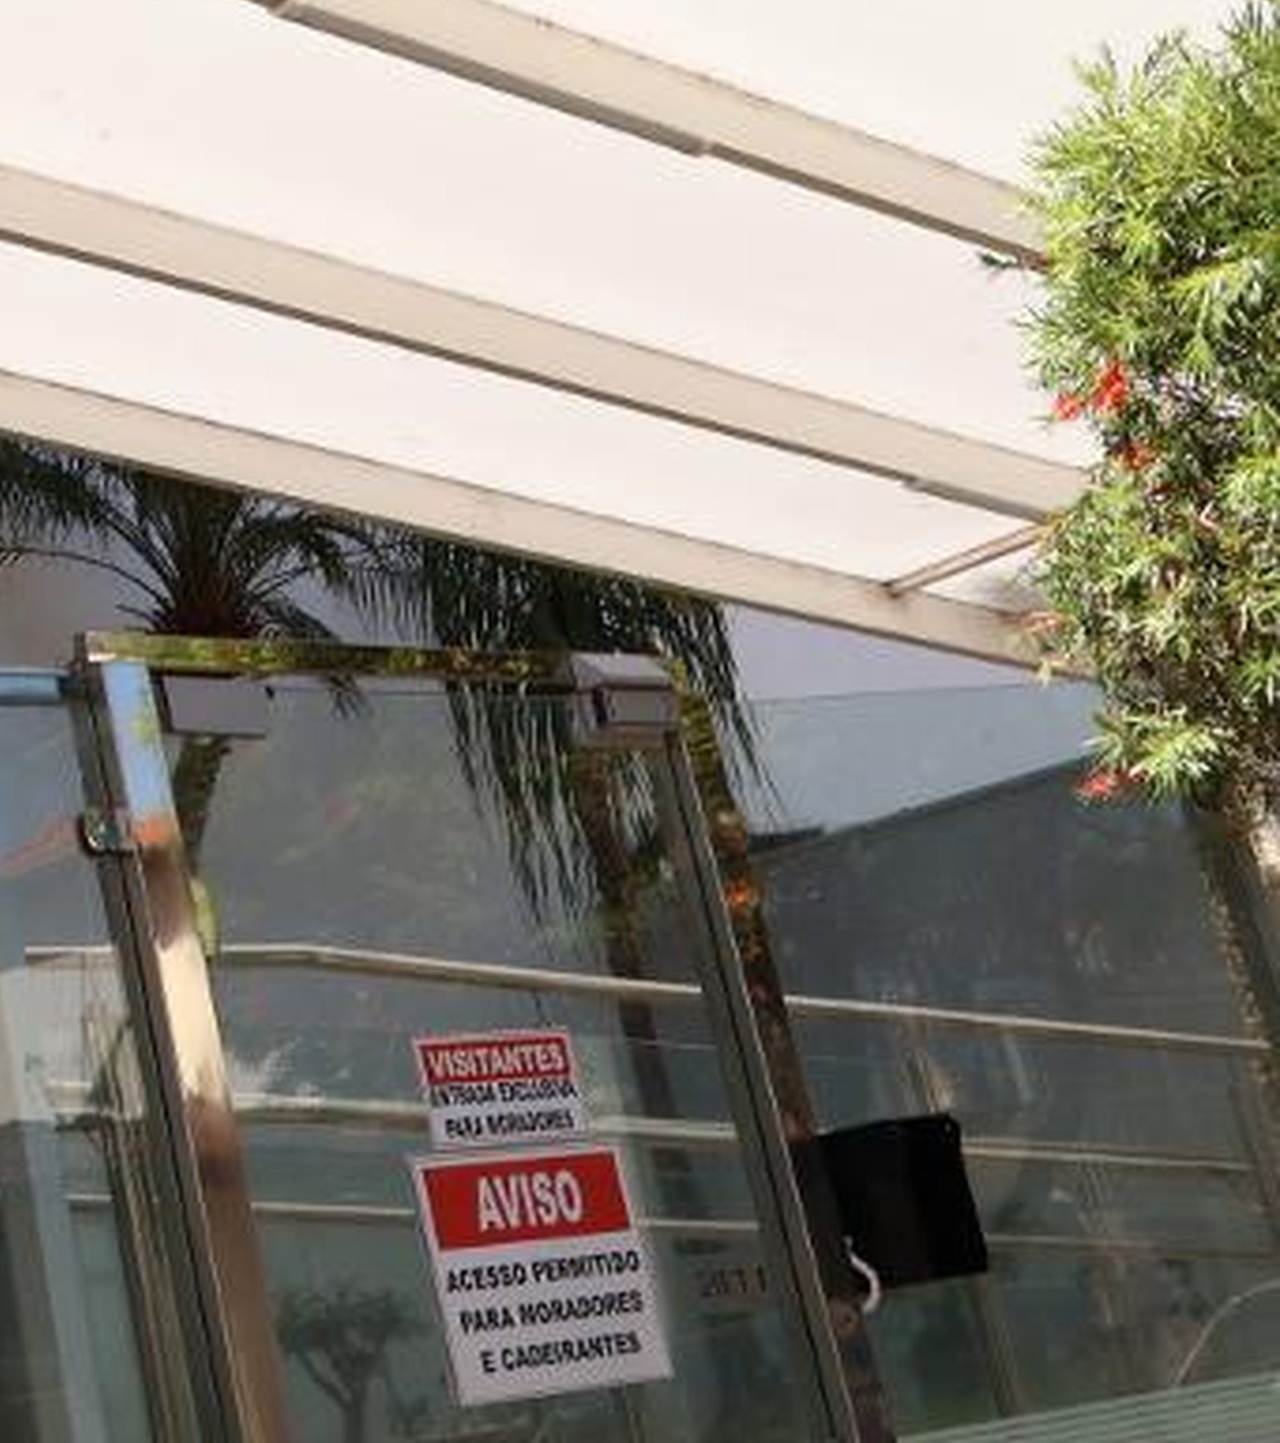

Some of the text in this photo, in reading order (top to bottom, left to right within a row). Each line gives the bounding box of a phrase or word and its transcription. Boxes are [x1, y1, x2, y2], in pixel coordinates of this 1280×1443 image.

[426, 1042, 566, 1079] VISITANTES
[445, 1117, 482, 1139] PARA
[476, 1170, 583, 1233] AVISO
[447, 1250, 641, 1293] ACESSO PERMITIDO
[460, 1290, 644, 1335] PARA MORADORES
[482, 1331, 641, 1373] E CADEIRANTES
